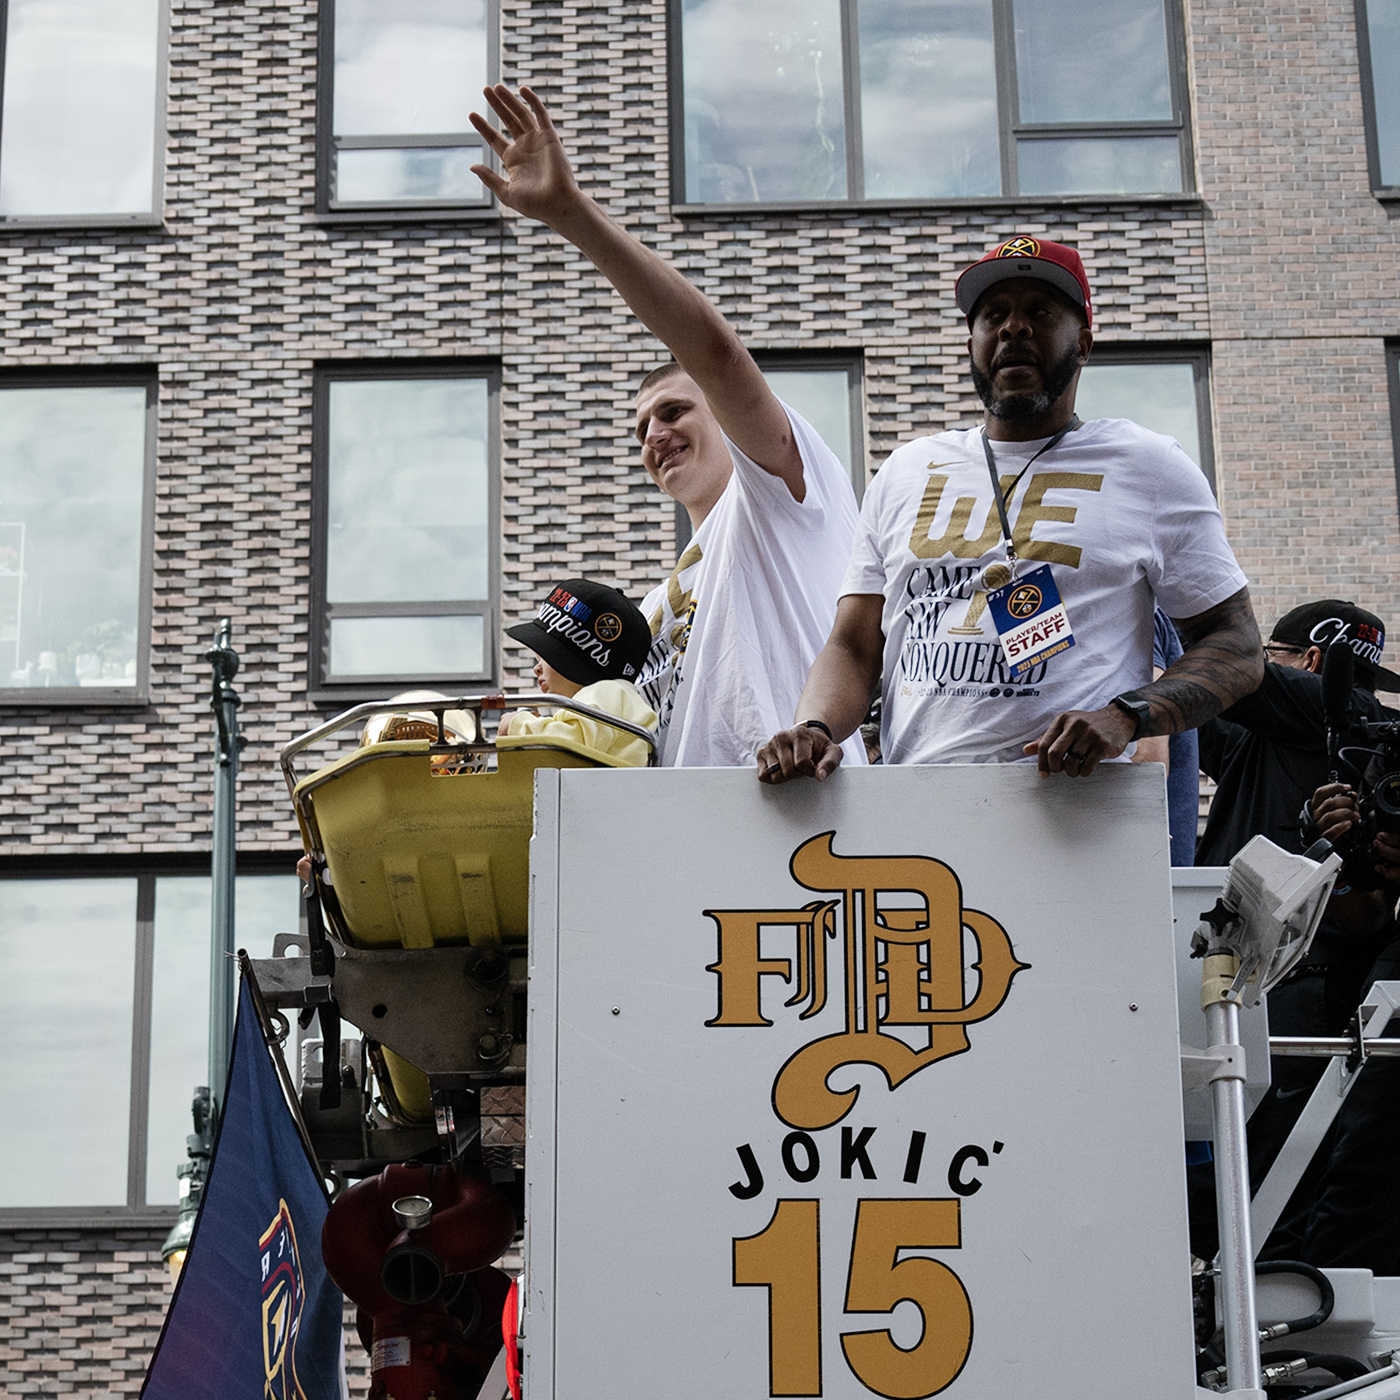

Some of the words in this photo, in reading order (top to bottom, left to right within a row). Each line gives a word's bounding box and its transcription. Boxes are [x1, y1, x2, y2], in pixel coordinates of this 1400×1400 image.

[909, 472, 1104, 568] WE
[1006, 612, 1062, 645] PLAYER/TEAM
[1008, 618, 1065, 657] STAFF
[732, 1198, 974, 1400] 15
